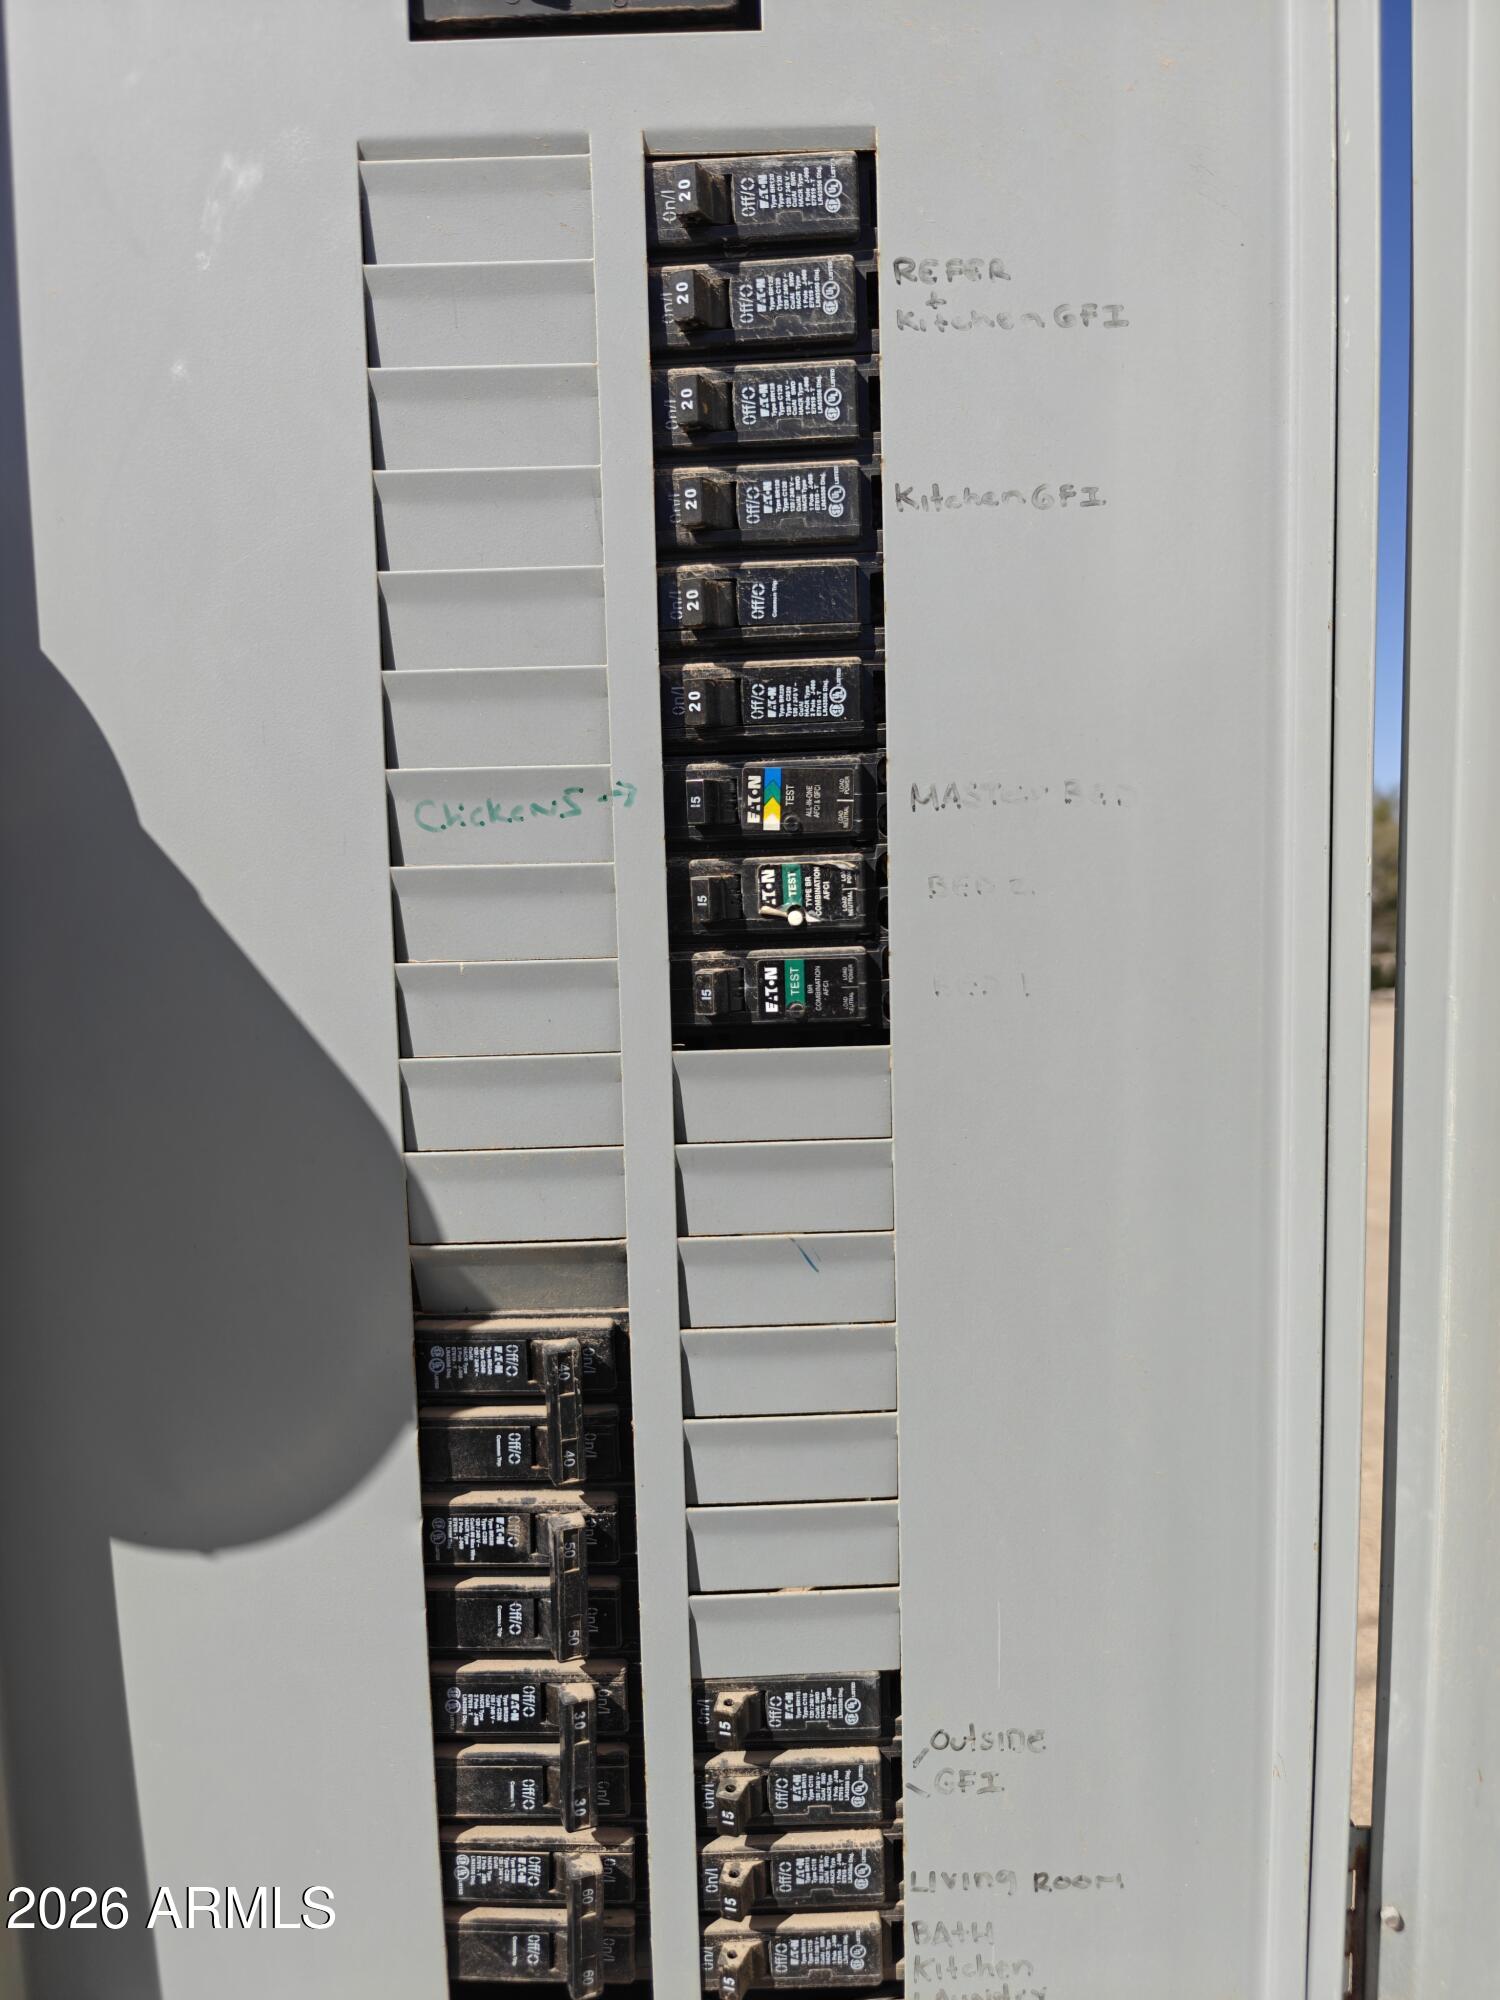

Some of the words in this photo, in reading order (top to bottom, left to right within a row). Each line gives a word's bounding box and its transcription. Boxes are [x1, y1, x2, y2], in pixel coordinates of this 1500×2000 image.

[678, 179, 691, 201] 20
[893, 256, 1011, 285] REFER
[676, 282, 689, 304] 20
[681, 388, 693, 410] 20
[685, 488, 697, 510] 20
[895, 482, 1026, 512] Kitchen
[1031, 483, 1101, 511] GFI
[686, 590, 700, 611] 20
[688, 691, 701, 712] 20
[690, 796, 701, 808] 15
[747, 775, 762, 823] EATON
[785, 784, 795, 806] TEST
[805, 785, 813, 817] ALL-IN-ONE
[787, 872, 797, 897] TEST
[805, 876, 812, 887] BR
[814, 866, 822, 916] COMBINATION
[822, 881, 831, 900] AFCI
[697, 895, 707, 906] 15
[805, 888, 813, 907] TYPE
[764, 967, 778, 1012] EATON
[789, 966, 800, 996] TEST
[807, 984, 814, 993] BR
[814, 965, 822, 1011] COMBINATION
[701, 989, 712, 1000] 15
[563, 1450, 576, 1467] 40
[564, 1542, 576, 1558] 50
[567, 1630, 580, 1646] 50
[574, 1711, 587, 1729] 30
[719, 1721, 731, 1736] 15
[573, 1798, 587, 1816] 30
[721, 1810, 735, 1825] 15
[582, 1888, 594, 1904] 60
[723, 1896, 738, 1912] 15
[582, 1970, 594, 1985] 60
[913, 1954, 1034, 1983] Kitchen
[722, 1976, 735, 1992] 15
